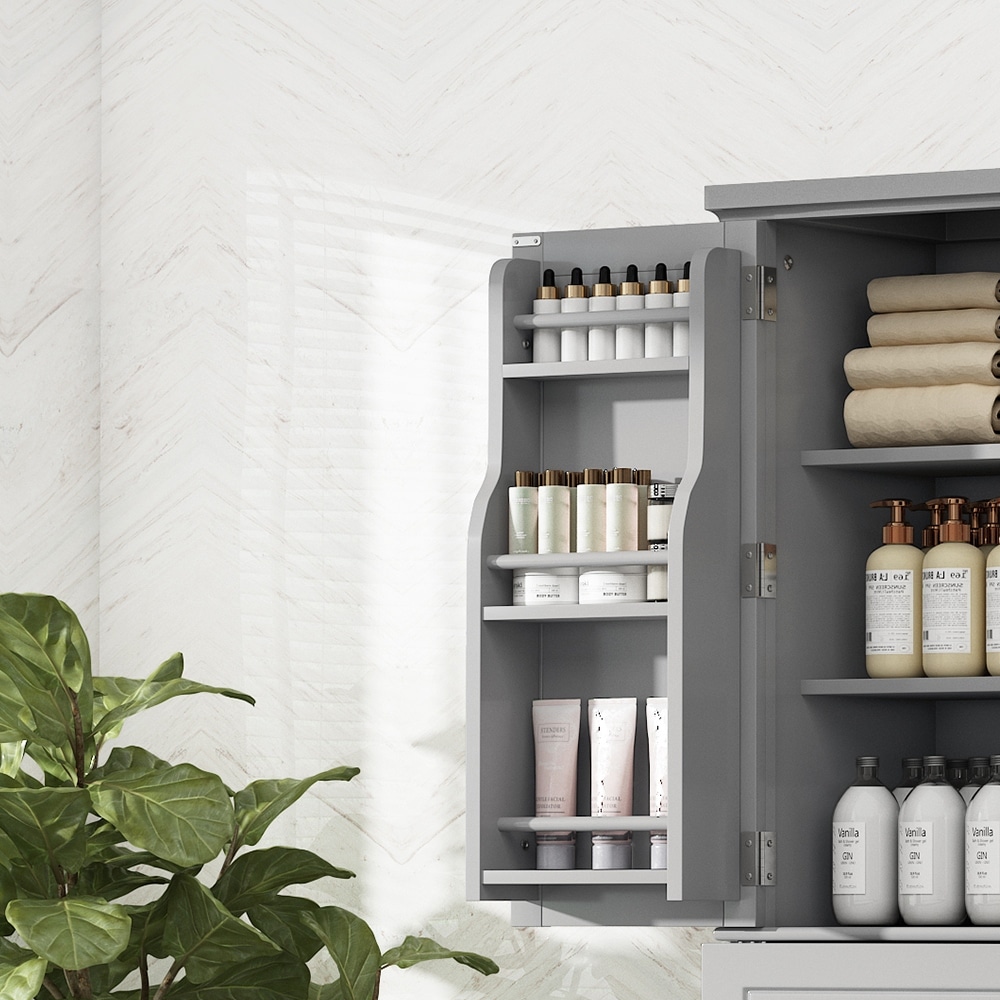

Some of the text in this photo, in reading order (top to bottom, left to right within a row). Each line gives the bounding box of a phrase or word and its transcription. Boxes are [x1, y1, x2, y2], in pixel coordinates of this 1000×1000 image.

[837, 827, 859, 838] Vanilla
[904, 827, 927, 837] Vanilla
[971, 826, 994, 837] Vanilla
[842, 851, 854, 860] GIN
[909, 851, 921, 860] GIN
[976, 851, 988, 860] GIN
